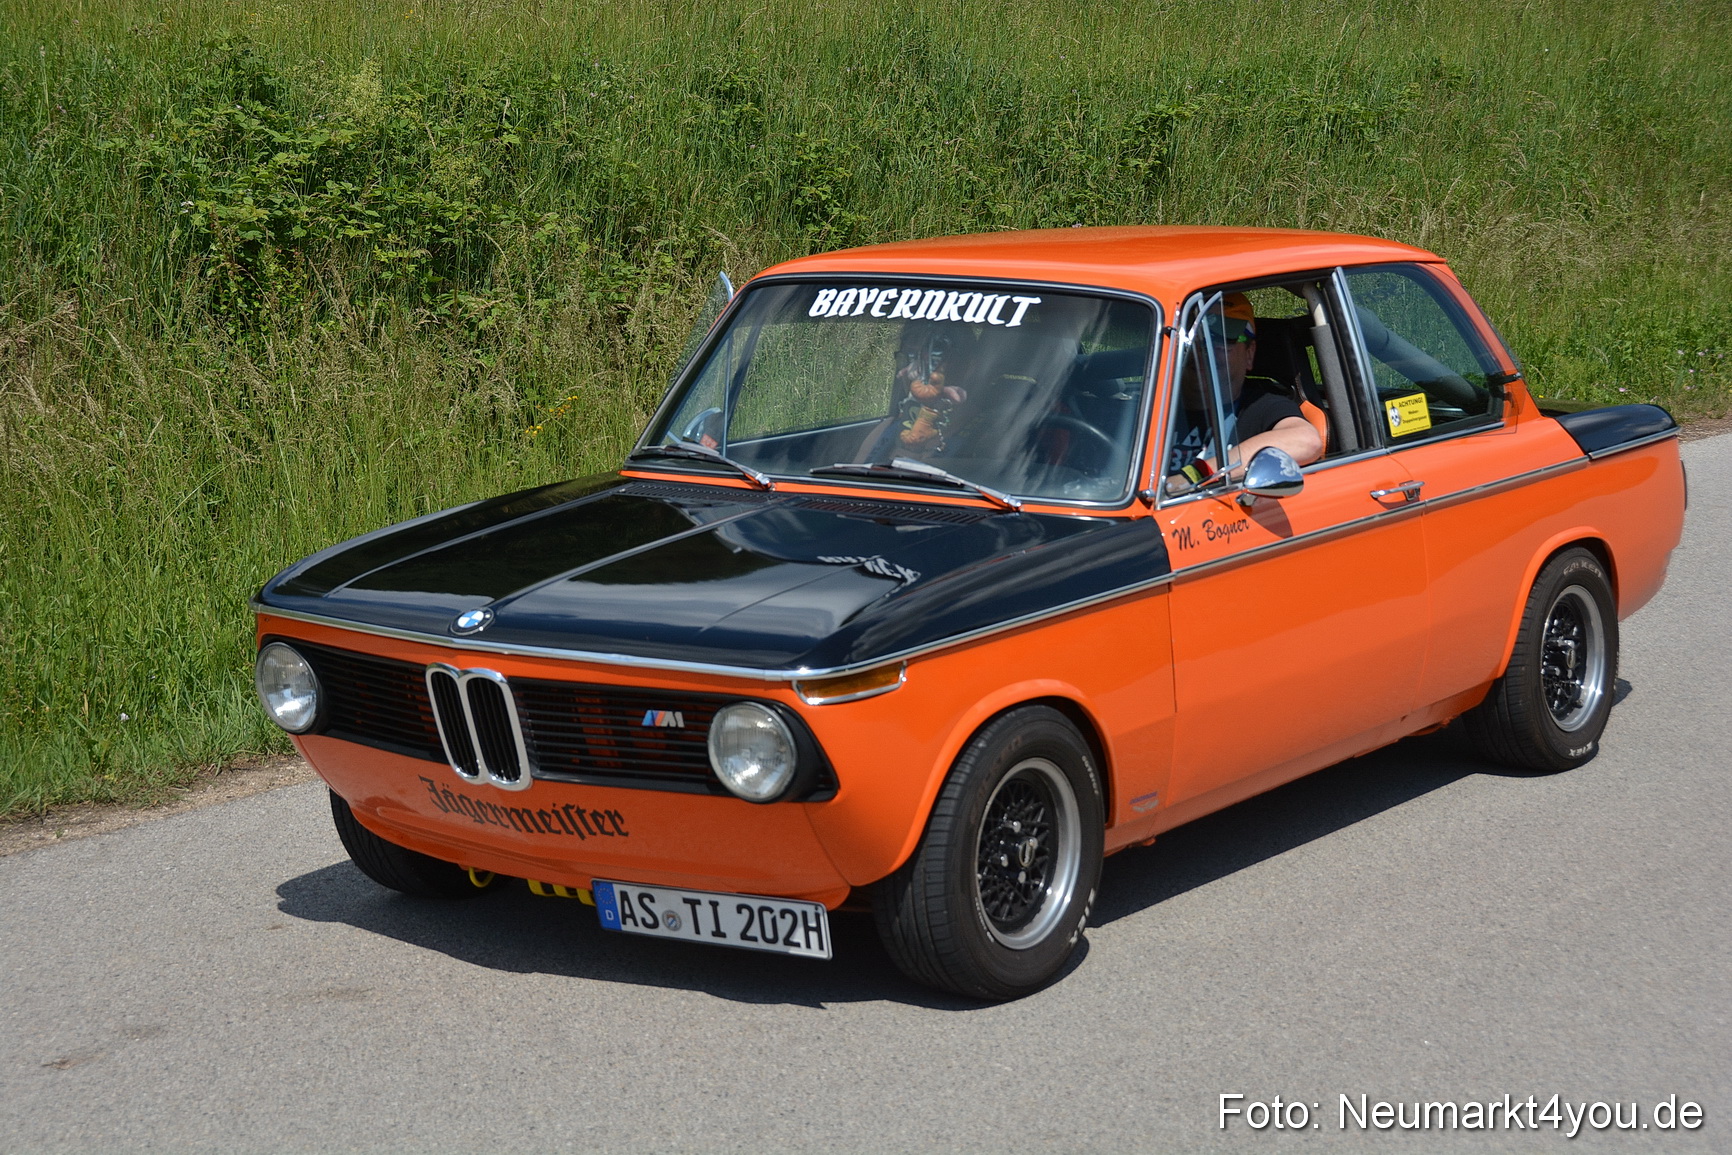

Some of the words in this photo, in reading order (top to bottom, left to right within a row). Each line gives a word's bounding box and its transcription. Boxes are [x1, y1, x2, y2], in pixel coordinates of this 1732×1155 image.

[808, 288, 1042, 328] BAYERNKULT
[1171, 525, 1200, 551] M.
[1202, 519, 1250, 544] Bogner
[605, 909, 614, 921] D
[619, 890, 660, 930] AS
[682, 897, 727, 939] TI
[735, 903, 825, 952] 202H
